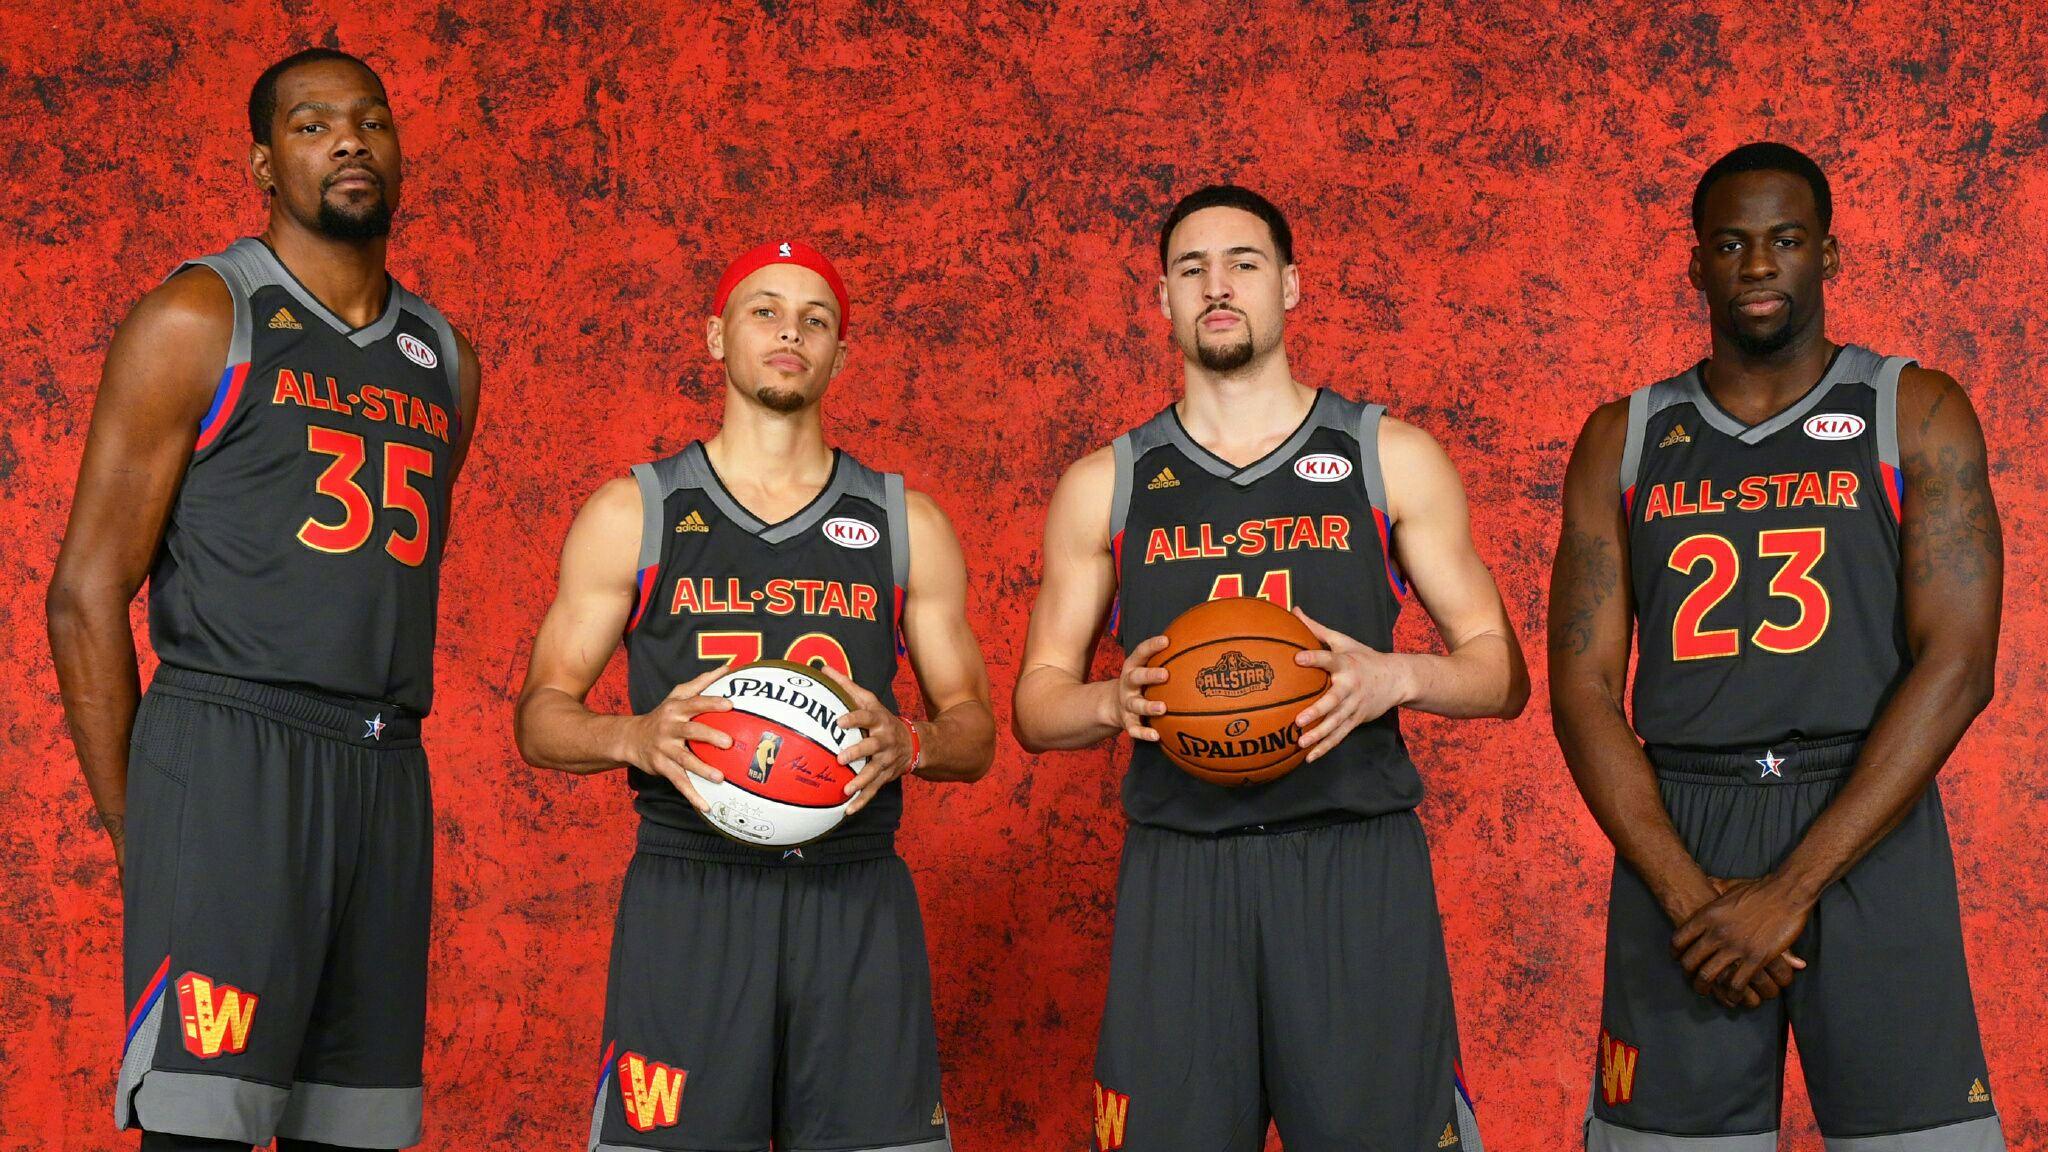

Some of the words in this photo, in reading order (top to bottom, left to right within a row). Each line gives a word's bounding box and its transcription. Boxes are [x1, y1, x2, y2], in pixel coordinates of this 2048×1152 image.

[268, 320, 303, 330] adidas
[1816, 420, 1852, 433] KIA
[1658, 434, 1691, 448] adidas
[1305, 461, 1340, 475] KIA
[296, 424, 433, 567] 35
[1147, 478, 1181, 490] adidas
[675, 520, 710, 533] adidas
[834, 524, 868, 542] KIA
[1668, 527, 1831, 661] 23
[723, 677, 846, 746] SPALDING
[1176, 720, 1303, 759] SPALDING
[748, 768, 762, 782] NBA
[191, 976, 256, 1055] W
[1603, 1031, 1636, 1103] W
[629, 1056, 682, 1128] W
[1095, 1082, 1127, 1151] W
